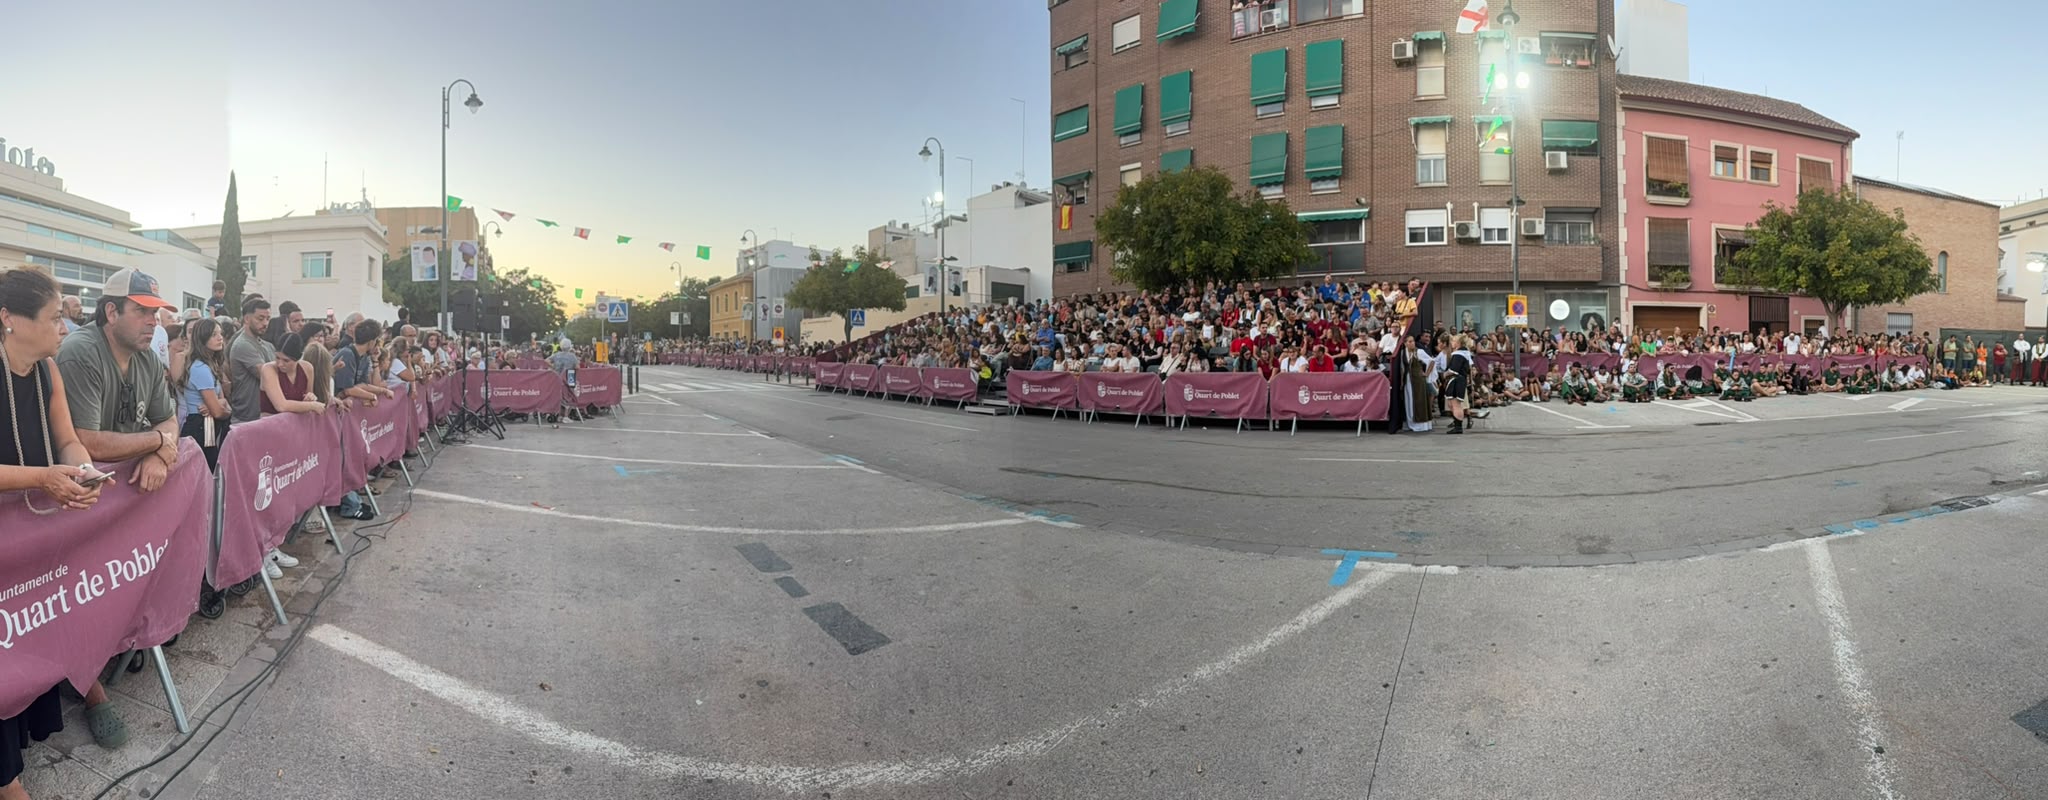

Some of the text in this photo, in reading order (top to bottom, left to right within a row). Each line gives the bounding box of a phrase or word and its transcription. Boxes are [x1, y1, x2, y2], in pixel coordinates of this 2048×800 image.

[1312, 393, 1332, 401] Quart
[273, 468, 296, 494] Quart
[55, 564, 69, 579] de
[74, 569, 106, 605] de
